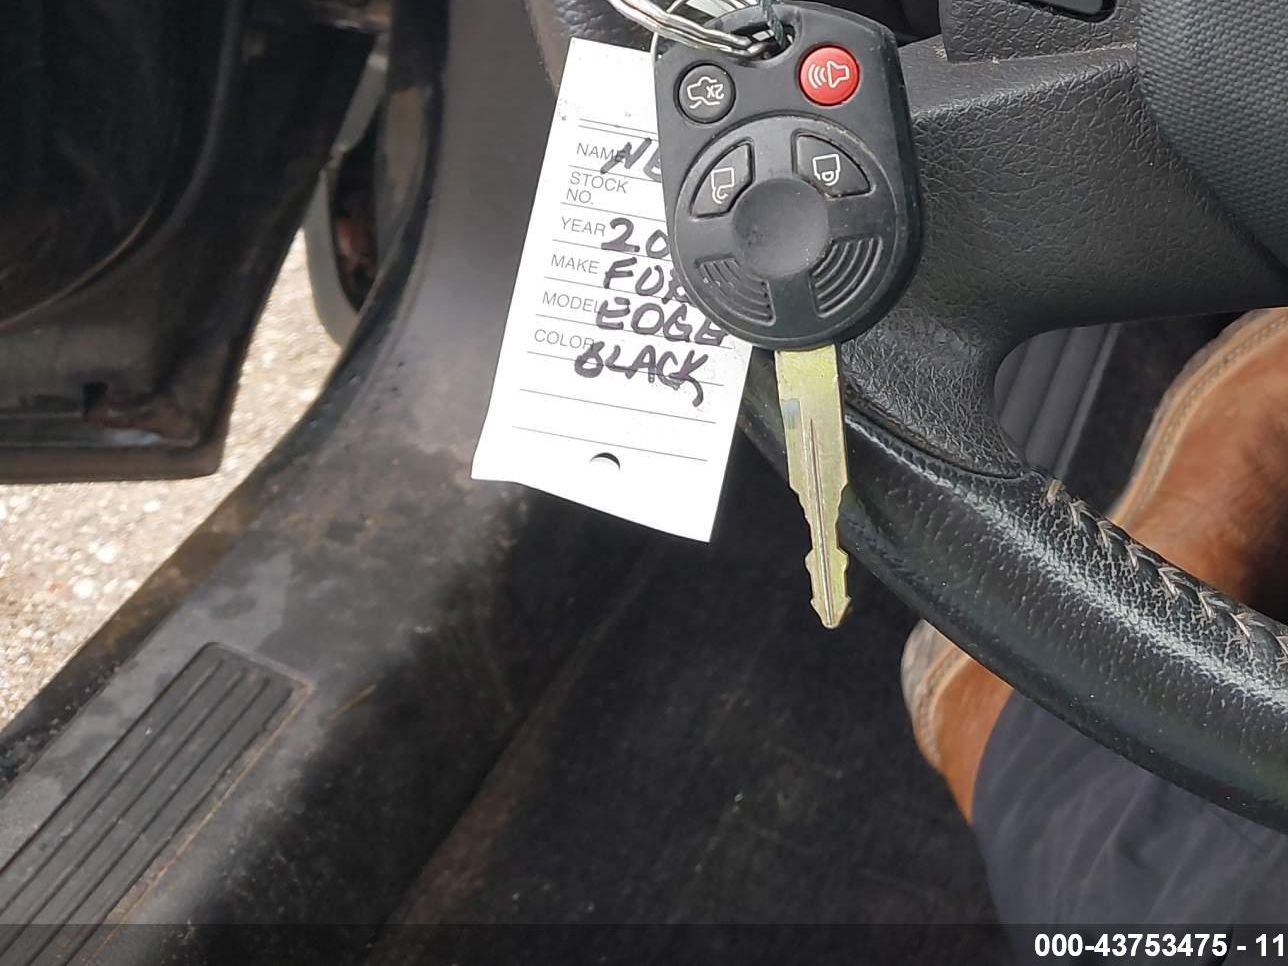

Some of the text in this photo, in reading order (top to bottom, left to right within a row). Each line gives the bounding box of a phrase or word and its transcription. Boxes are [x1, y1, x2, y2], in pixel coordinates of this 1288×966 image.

[569, 171, 629, 194] STOCK
[566, 187, 594, 205] NO.
[560, 216, 606, 237] YEAR
[551, 253, 600, 274] MAKE
[542, 291, 600, 313] MODEL
[574, 340, 709, 407] BLACK
